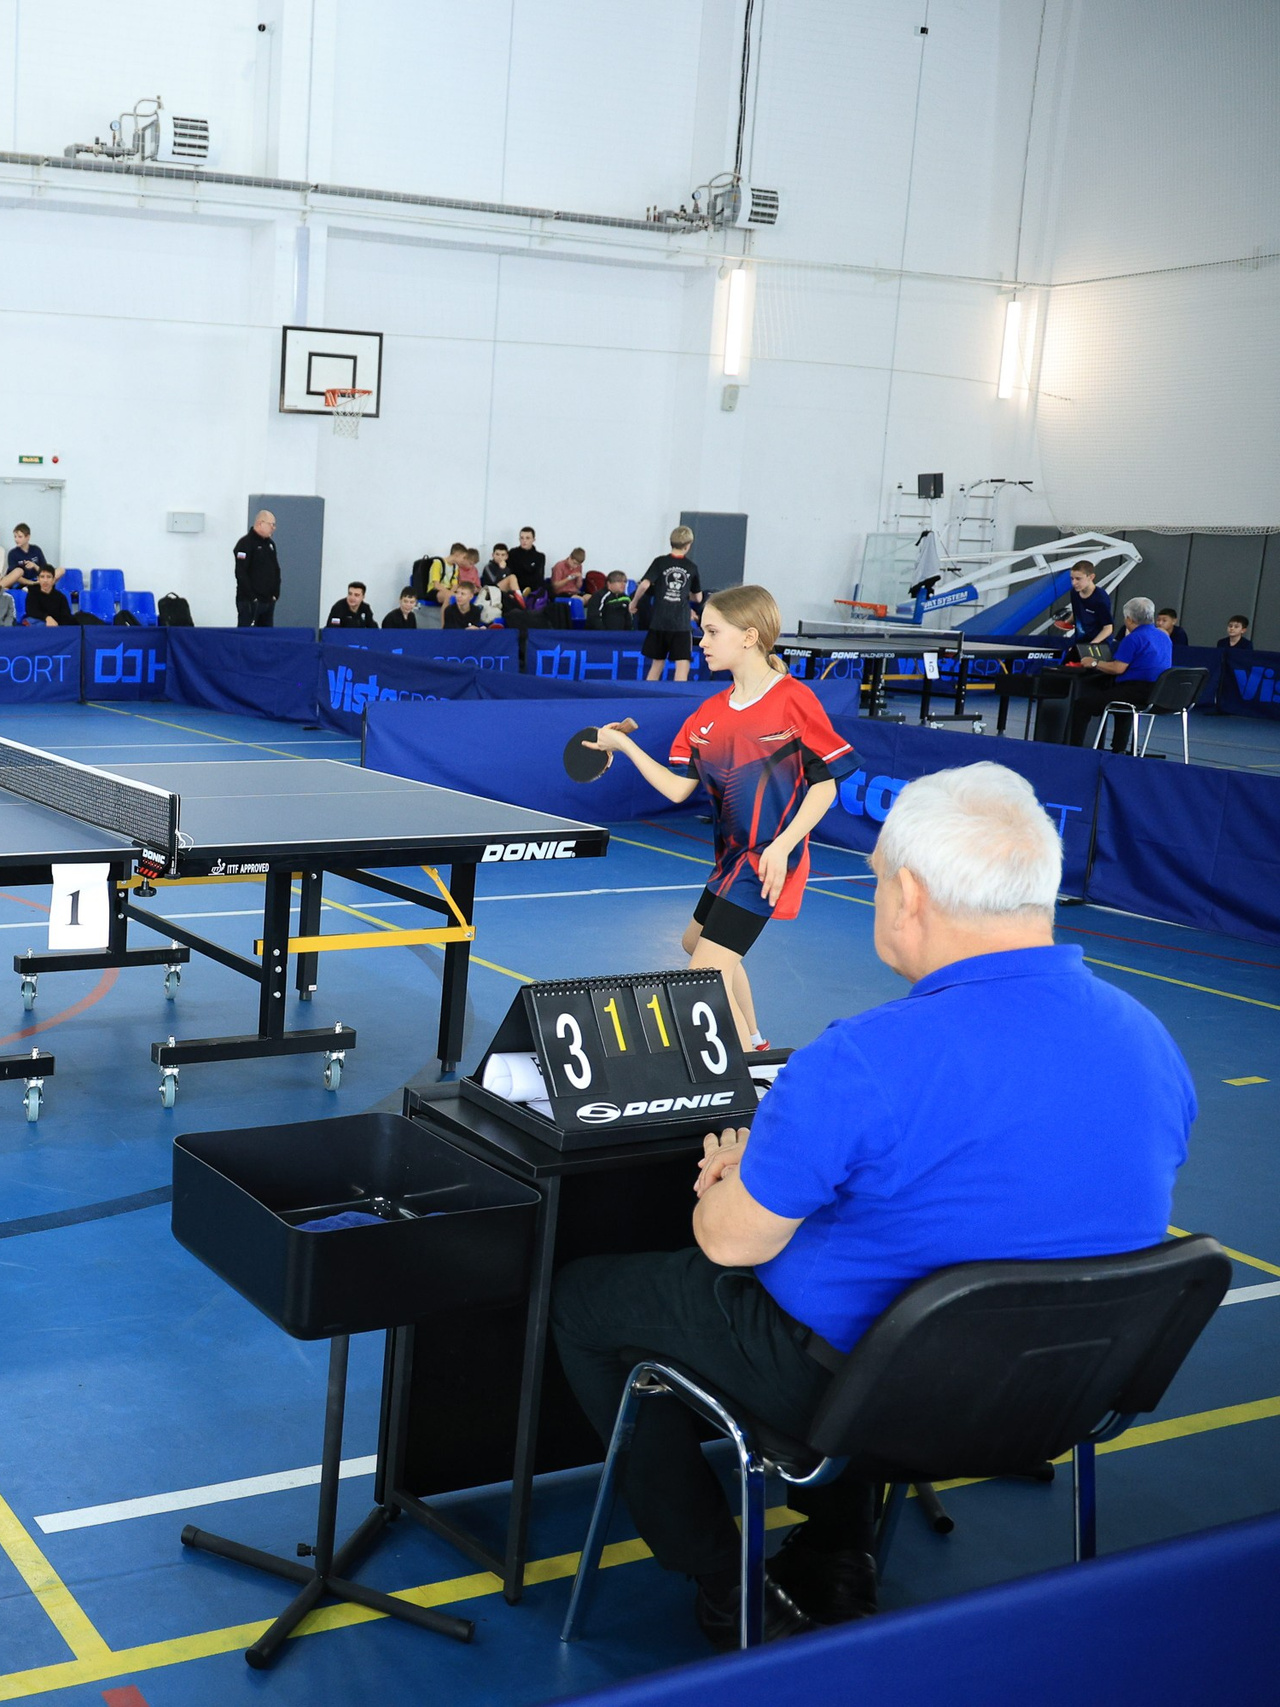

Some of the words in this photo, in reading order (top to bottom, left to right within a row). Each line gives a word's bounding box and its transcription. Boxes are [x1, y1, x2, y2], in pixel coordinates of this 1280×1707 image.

[783, 648, 812, 657] DONIC
[831, 651, 860, 659] DONIC
[928, 660, 935, 673] 5
[142, 848, 166, 865] DONIC
[481, 840, 576, 863] DONIC
[227, 864, 239, 874] ITTF
[240, 862, 270, 874] APPROVED
[65, 890, 84, 926] 1
[555, 1012, 593, 1090] 3
[603, 997, 627, 1052] 1
[646, 993, 671, 1048] 1
[691, 1000, 729, 1076] 3
[622, 1091, 735, 1117] DONIC
